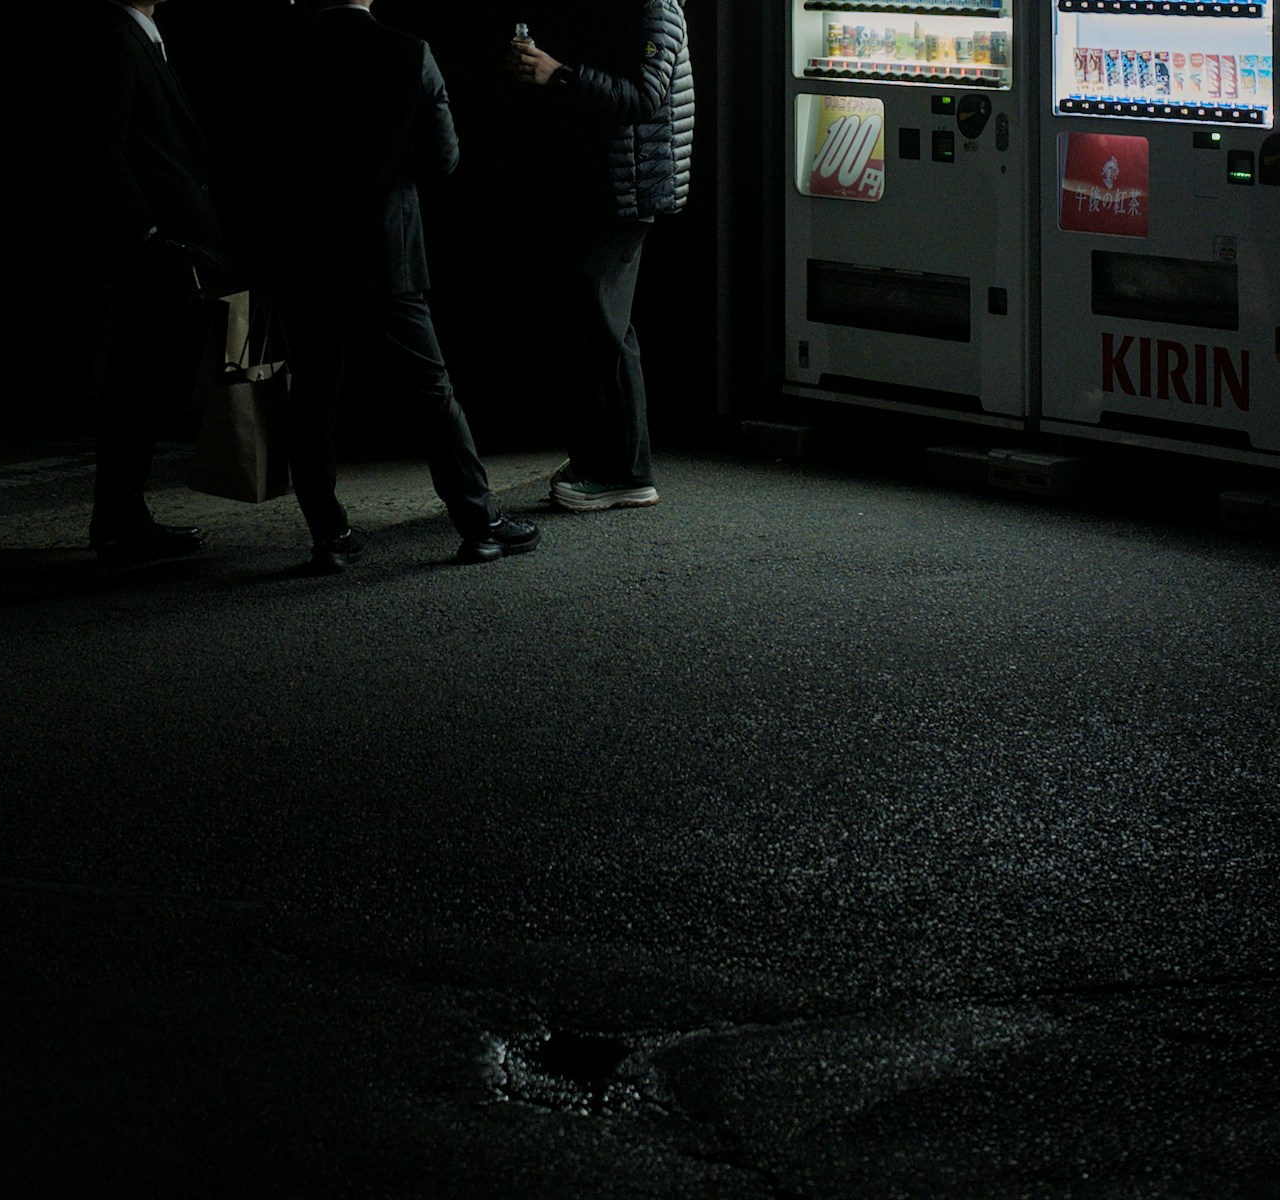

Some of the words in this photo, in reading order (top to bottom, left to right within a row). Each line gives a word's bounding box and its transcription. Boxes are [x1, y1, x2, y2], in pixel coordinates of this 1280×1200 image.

[1074, 184, 1141, 217] 午後の紅茶
[1102, 332, 1250, 412] KIRIN
